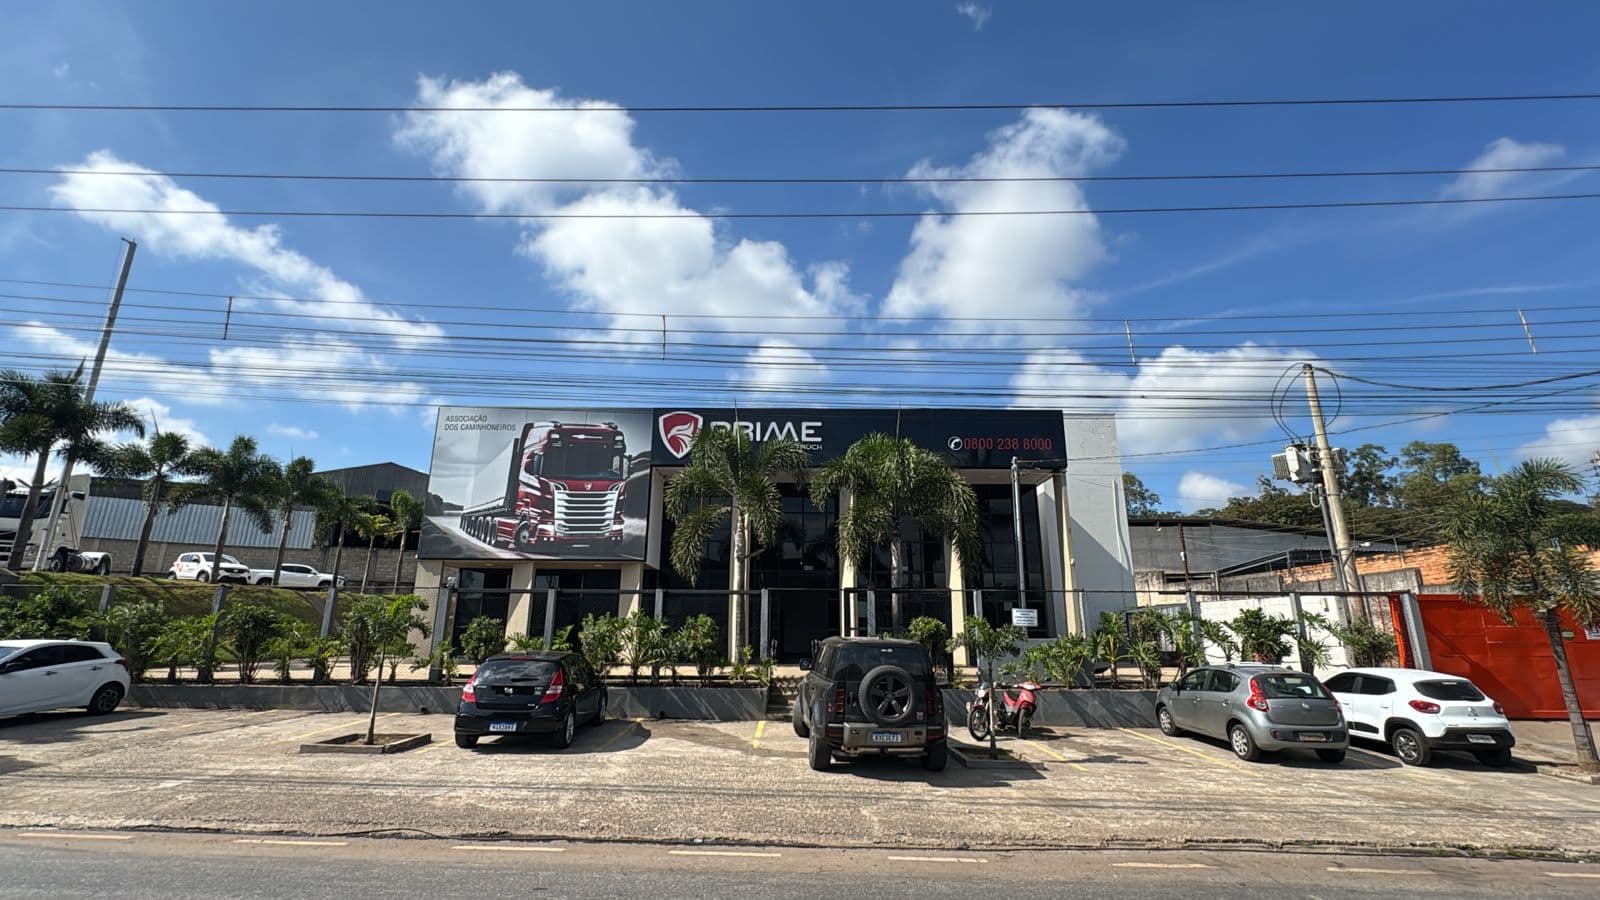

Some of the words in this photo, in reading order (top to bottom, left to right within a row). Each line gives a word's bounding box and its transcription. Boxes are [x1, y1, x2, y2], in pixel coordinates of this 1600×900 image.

[710, 421, 822, 442] PRIME
[963, 438, 993, 450] 0800
[997, 438, 1019, 450] 238
[1023, 438, 1052, 450] 8000
